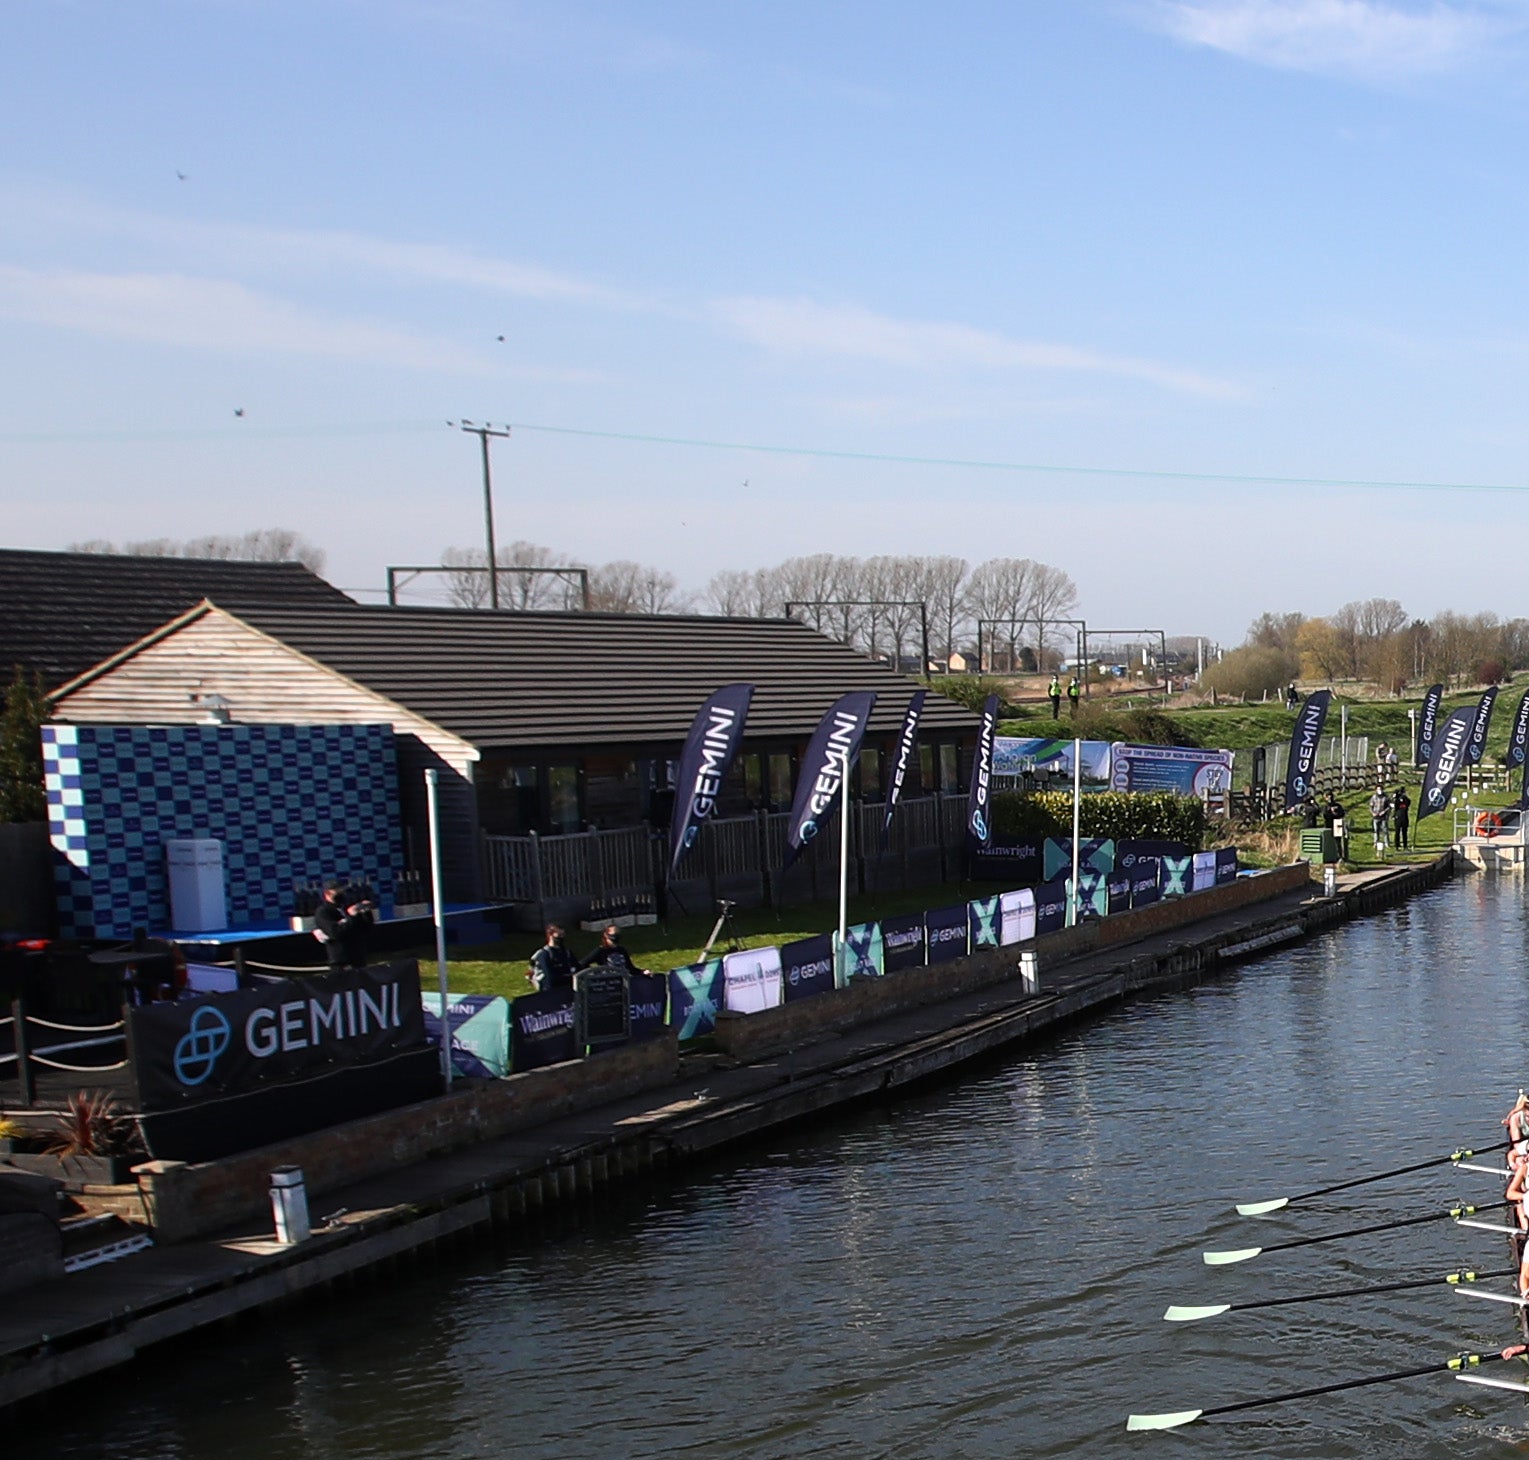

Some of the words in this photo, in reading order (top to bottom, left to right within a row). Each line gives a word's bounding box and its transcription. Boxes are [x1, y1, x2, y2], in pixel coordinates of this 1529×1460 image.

[1299, 704, 1321, 773] GEMINI
[1423, 693, 1438, 741] GEMINI
[1474, 696, 1492, 743] GEMINI
[692, 706, 735, 818] GEMINI
[810, 711, 859, 815] GEMINI
[976, 712, 993, 805] GEMINI
[1435, 718, 1467, 785] GEMINI
[245, 982, 400, 1057] GEMINI
[519, 1003, 575, 1036] Wainwrig
[629, 1001, 663, 1020] EMINI
